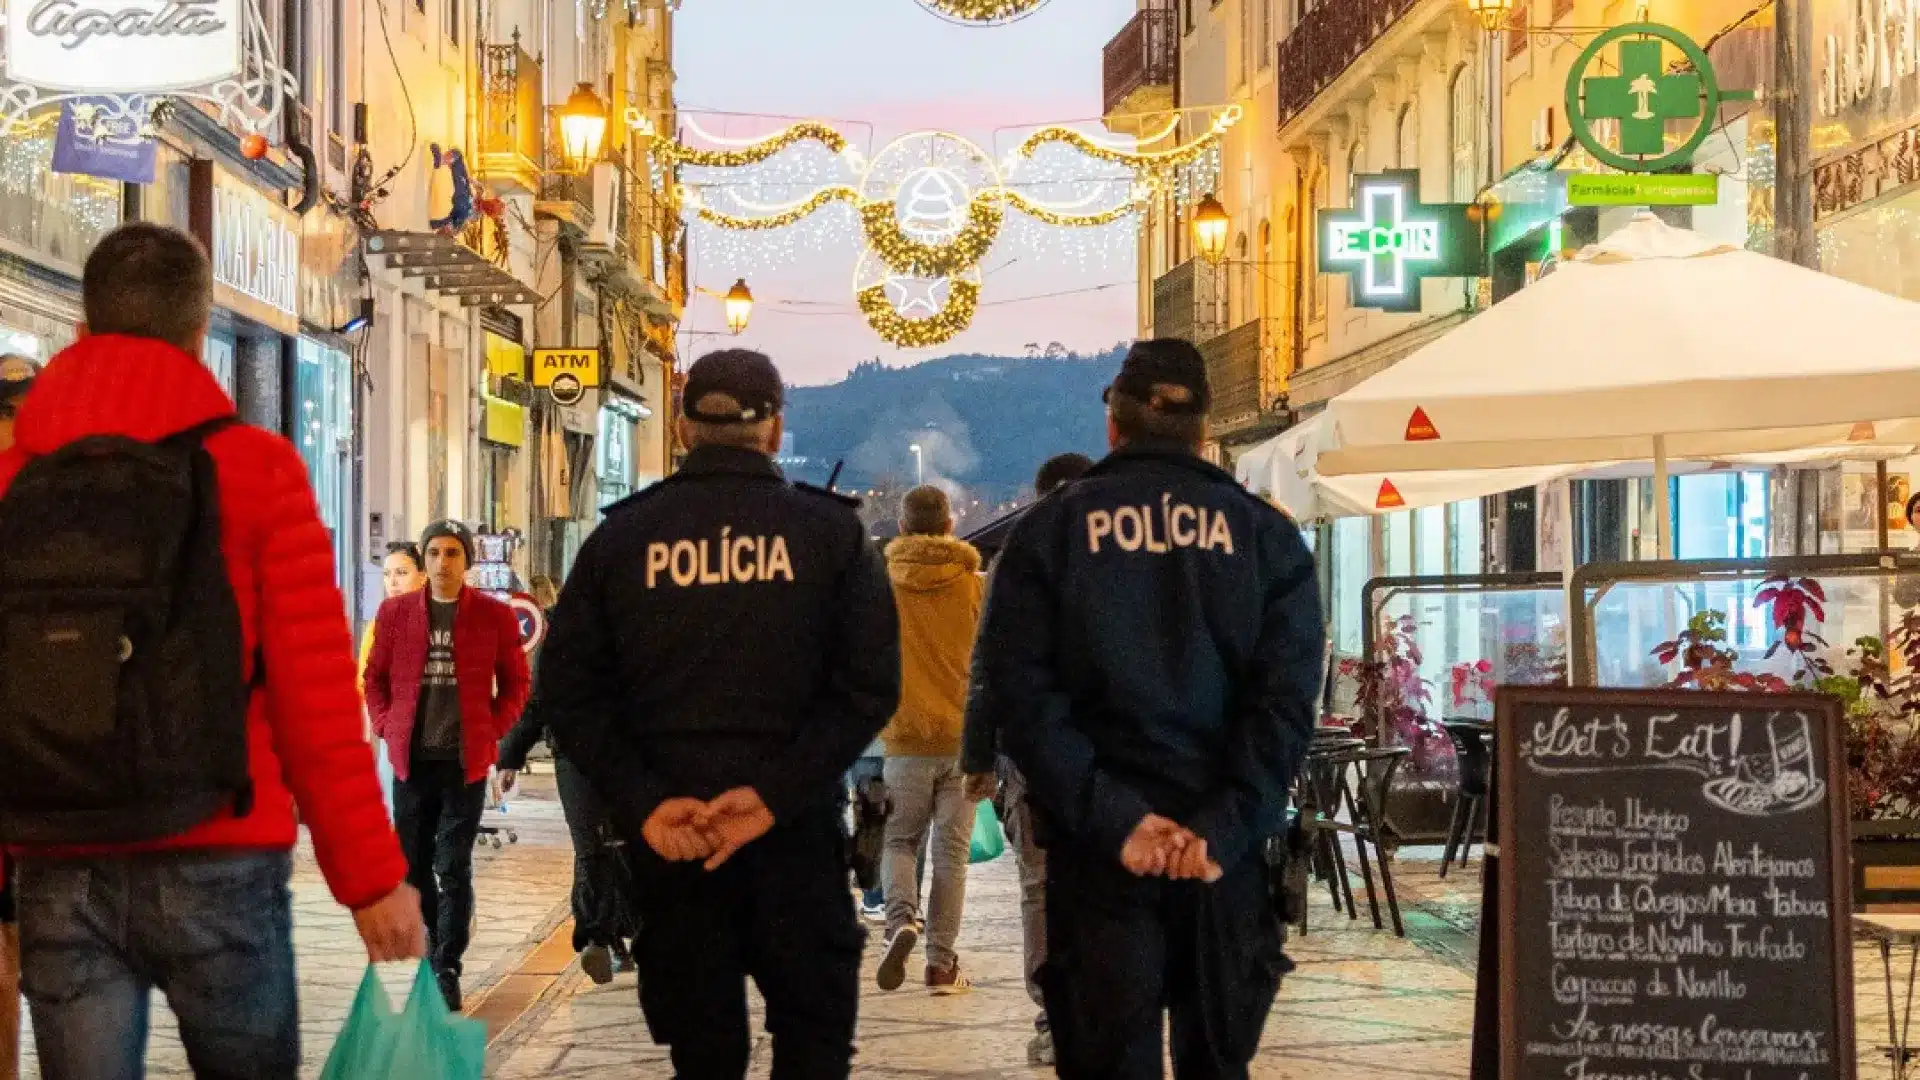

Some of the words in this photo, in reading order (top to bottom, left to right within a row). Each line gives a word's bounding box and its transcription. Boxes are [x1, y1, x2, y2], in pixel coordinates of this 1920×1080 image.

[543, 354, 590, 368] ATM
[1087, 492, 1233, 554] POLÍCIA
[646, 525, 794, 588] POLÍCIA
[1533, 707, 1631, 757] Let's
[1645, 713, 1741, 766] Eat!
[1618, 926, 1646, 951] de
[1649, 923, 1724, 957] Novilho
[1725, 923, 1805, 960] Trufado
[1675, 967, 1747, 999] Novilho
